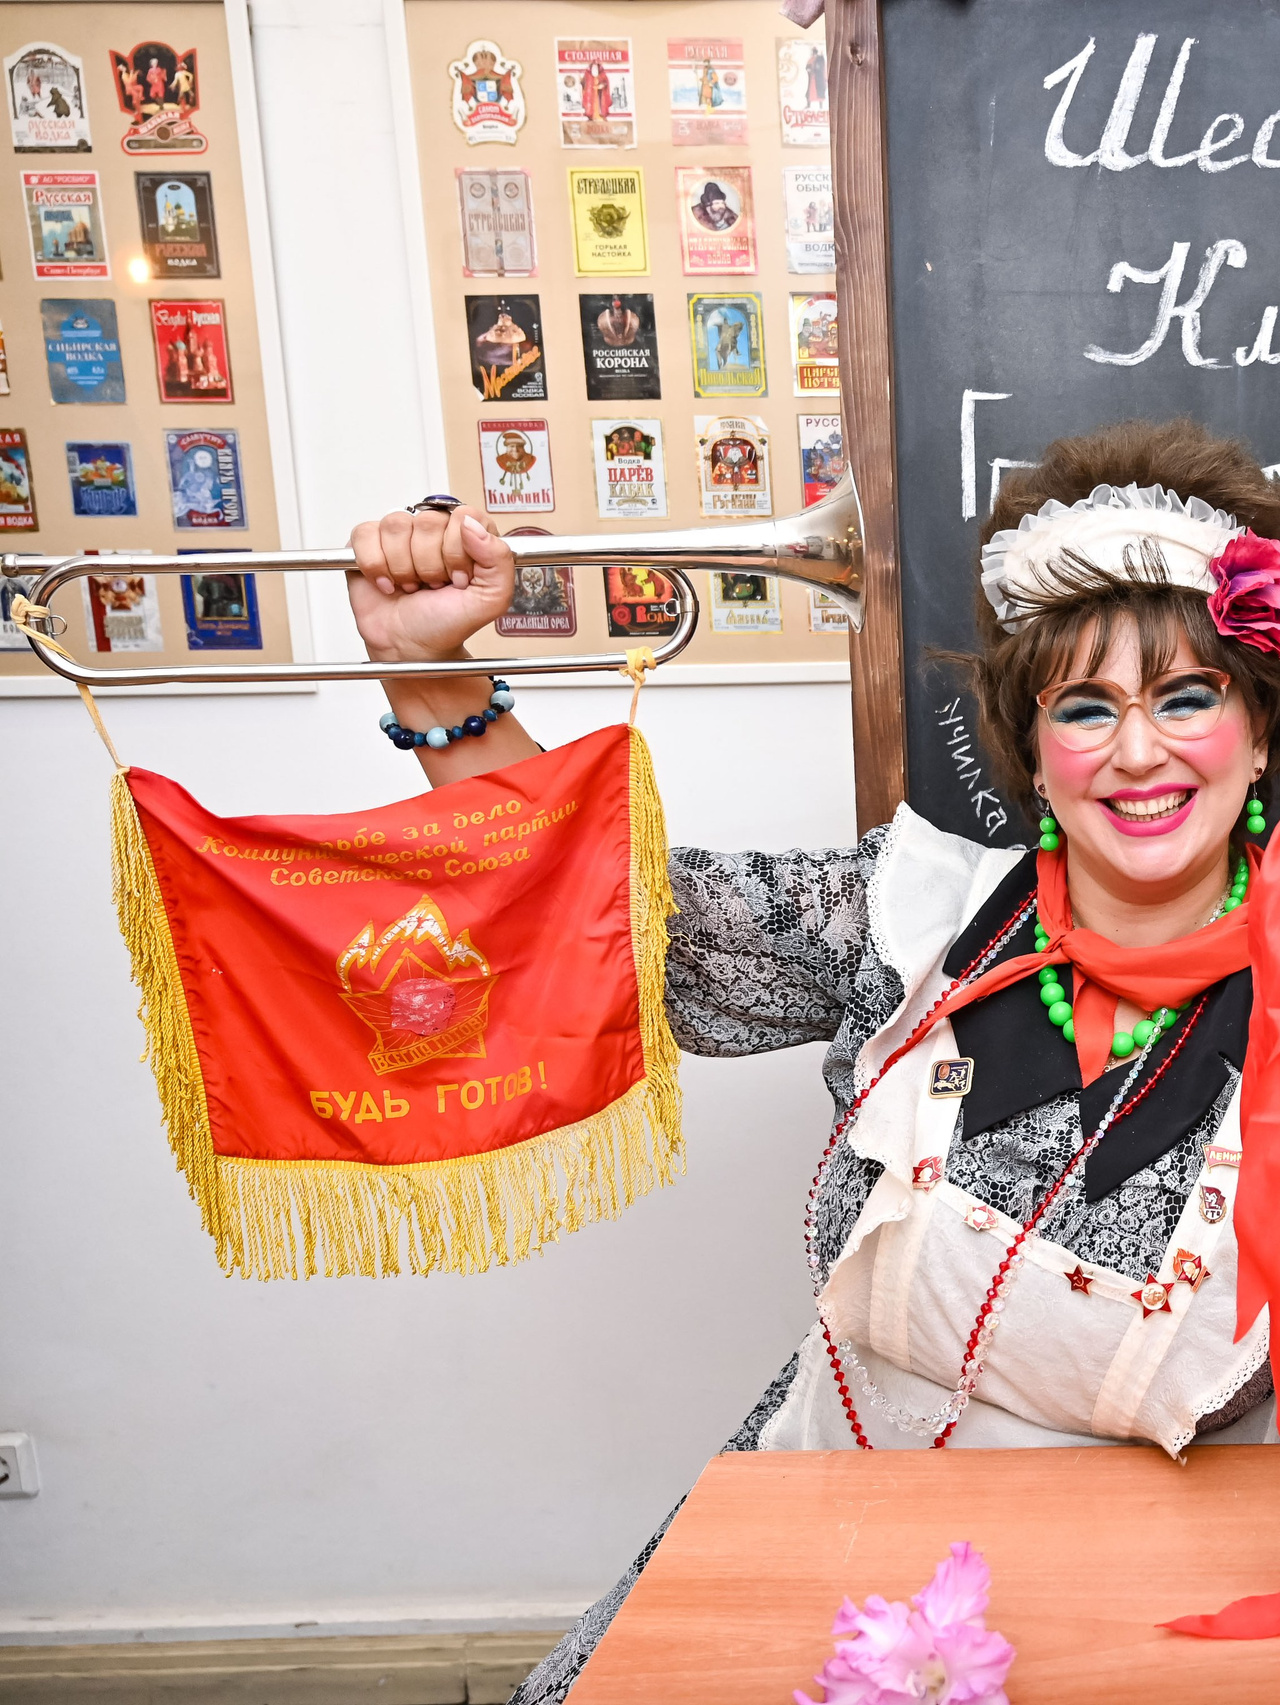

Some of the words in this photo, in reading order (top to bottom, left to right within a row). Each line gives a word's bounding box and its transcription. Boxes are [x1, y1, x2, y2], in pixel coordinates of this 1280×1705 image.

[564, 50, 622, 61] СТОЛИЧНАЯ
[795, 173, 830, 183] РУССК
[576, 177, 636, 195] СТРЕЛЕЦКАЯ
[34, 190, 92, 205] Русская
[591, 250, 632, 258] НАСТОЙКА
[48, 342, 118, 353] СИБИРСКАЯ
[592, 348, 651, 357] РОССИЙСКАЯ
[596, 357, 649, 368] КОРОНА
[618, 457, 641, 465] Водка
[607, 465, 654, 482] ЦАРЁВ
[608, 482, 656, 499] КАБАК
[501, 615, 549, 630] ДЕРЖАВНЫЙ
[551, 616, 570, 629] ОРЕЛ
[402, 822, 442, 841] за
[453, 799, 522, 830] дело
[482, 797, 580, 845] партии
[269, 862, 434, 888] Советского
[444, 845, 532, 878] Союза
[309, 1089, 411, 1125] БУДЬ
